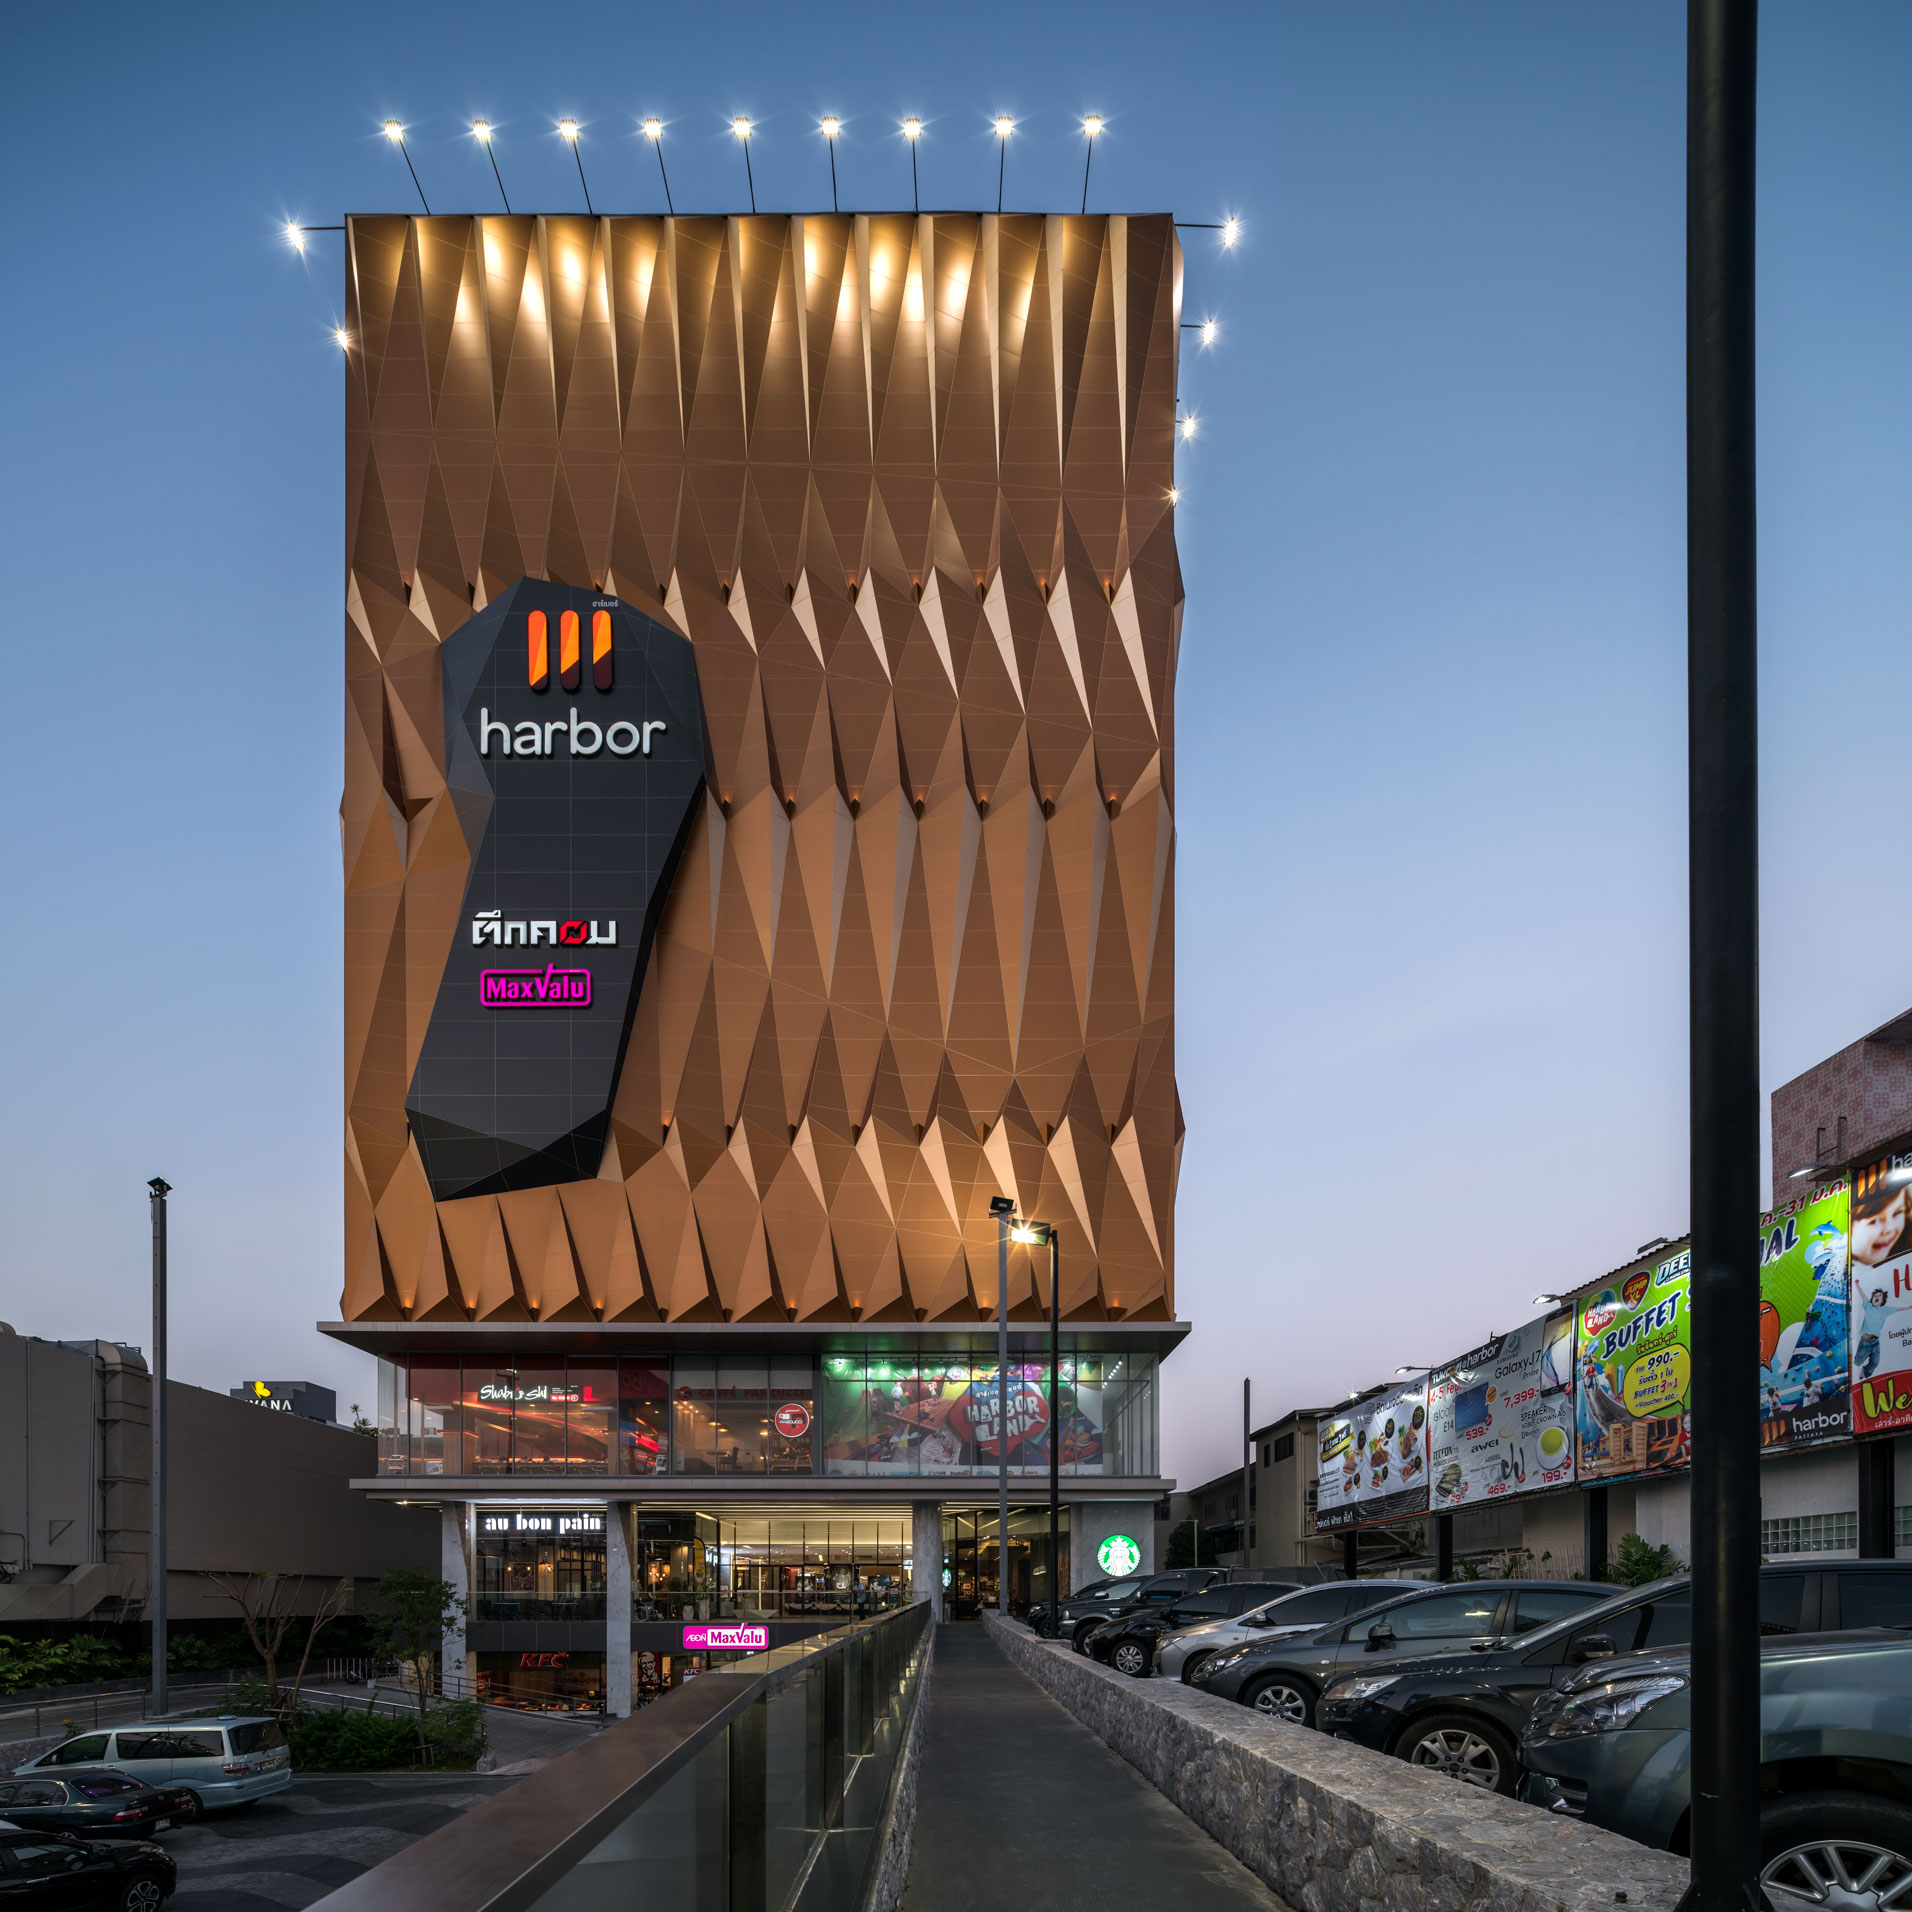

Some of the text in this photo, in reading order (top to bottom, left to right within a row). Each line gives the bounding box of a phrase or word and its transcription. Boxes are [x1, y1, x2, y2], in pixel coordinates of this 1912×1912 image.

[480, 707, 666, 755] harbor
[472, 910, 617, 945] ตึกคอม
[486, 963, 584, 999] MaxValu
[1656, 1253, 1690, 1286] DEE
[1626, 1279, 1647, 1295] JUMP
[1629, 1292, 1641, 1305] XL
[1587, 1313, 1610, 1328] LAND
[1603, 1291, 1681, 1358] BUFFET
[1467, 1344, 1499, 1368] harbor
[1648, 1351, 1680, 1371] 990.-
[1495, 1357, 1529, 1379] Galaxy
[1522, 1369, 1540, 1379] Prime
[1504, 1387, 1540, 1408] 7,399.-
[1633, 1384, 1660, 1399] BUFFET
[1660, 1379, 1667, 1393] 3
[967, 1396, 1040, 1422] HARBOR
[1521, 1405, 1548, 1421] SPEAKER
[1537, 1413, 1557, 1424] CROWN
[1792, 1410, 1848, 1433] harbor
[1466, 1426, 1489, 1440] 539.-
[1794, 1431, 1824, 1440] PATTAYA
[1541, 1470, 1567, 1483] 199.-
[1488, 1483, 1511, 1495] 469.-
[485, 1513, 601, 1534] au bon pain
[710, 1622, 763, 1644] MaxValu
[520, 1652, 567, 1668] KFC
